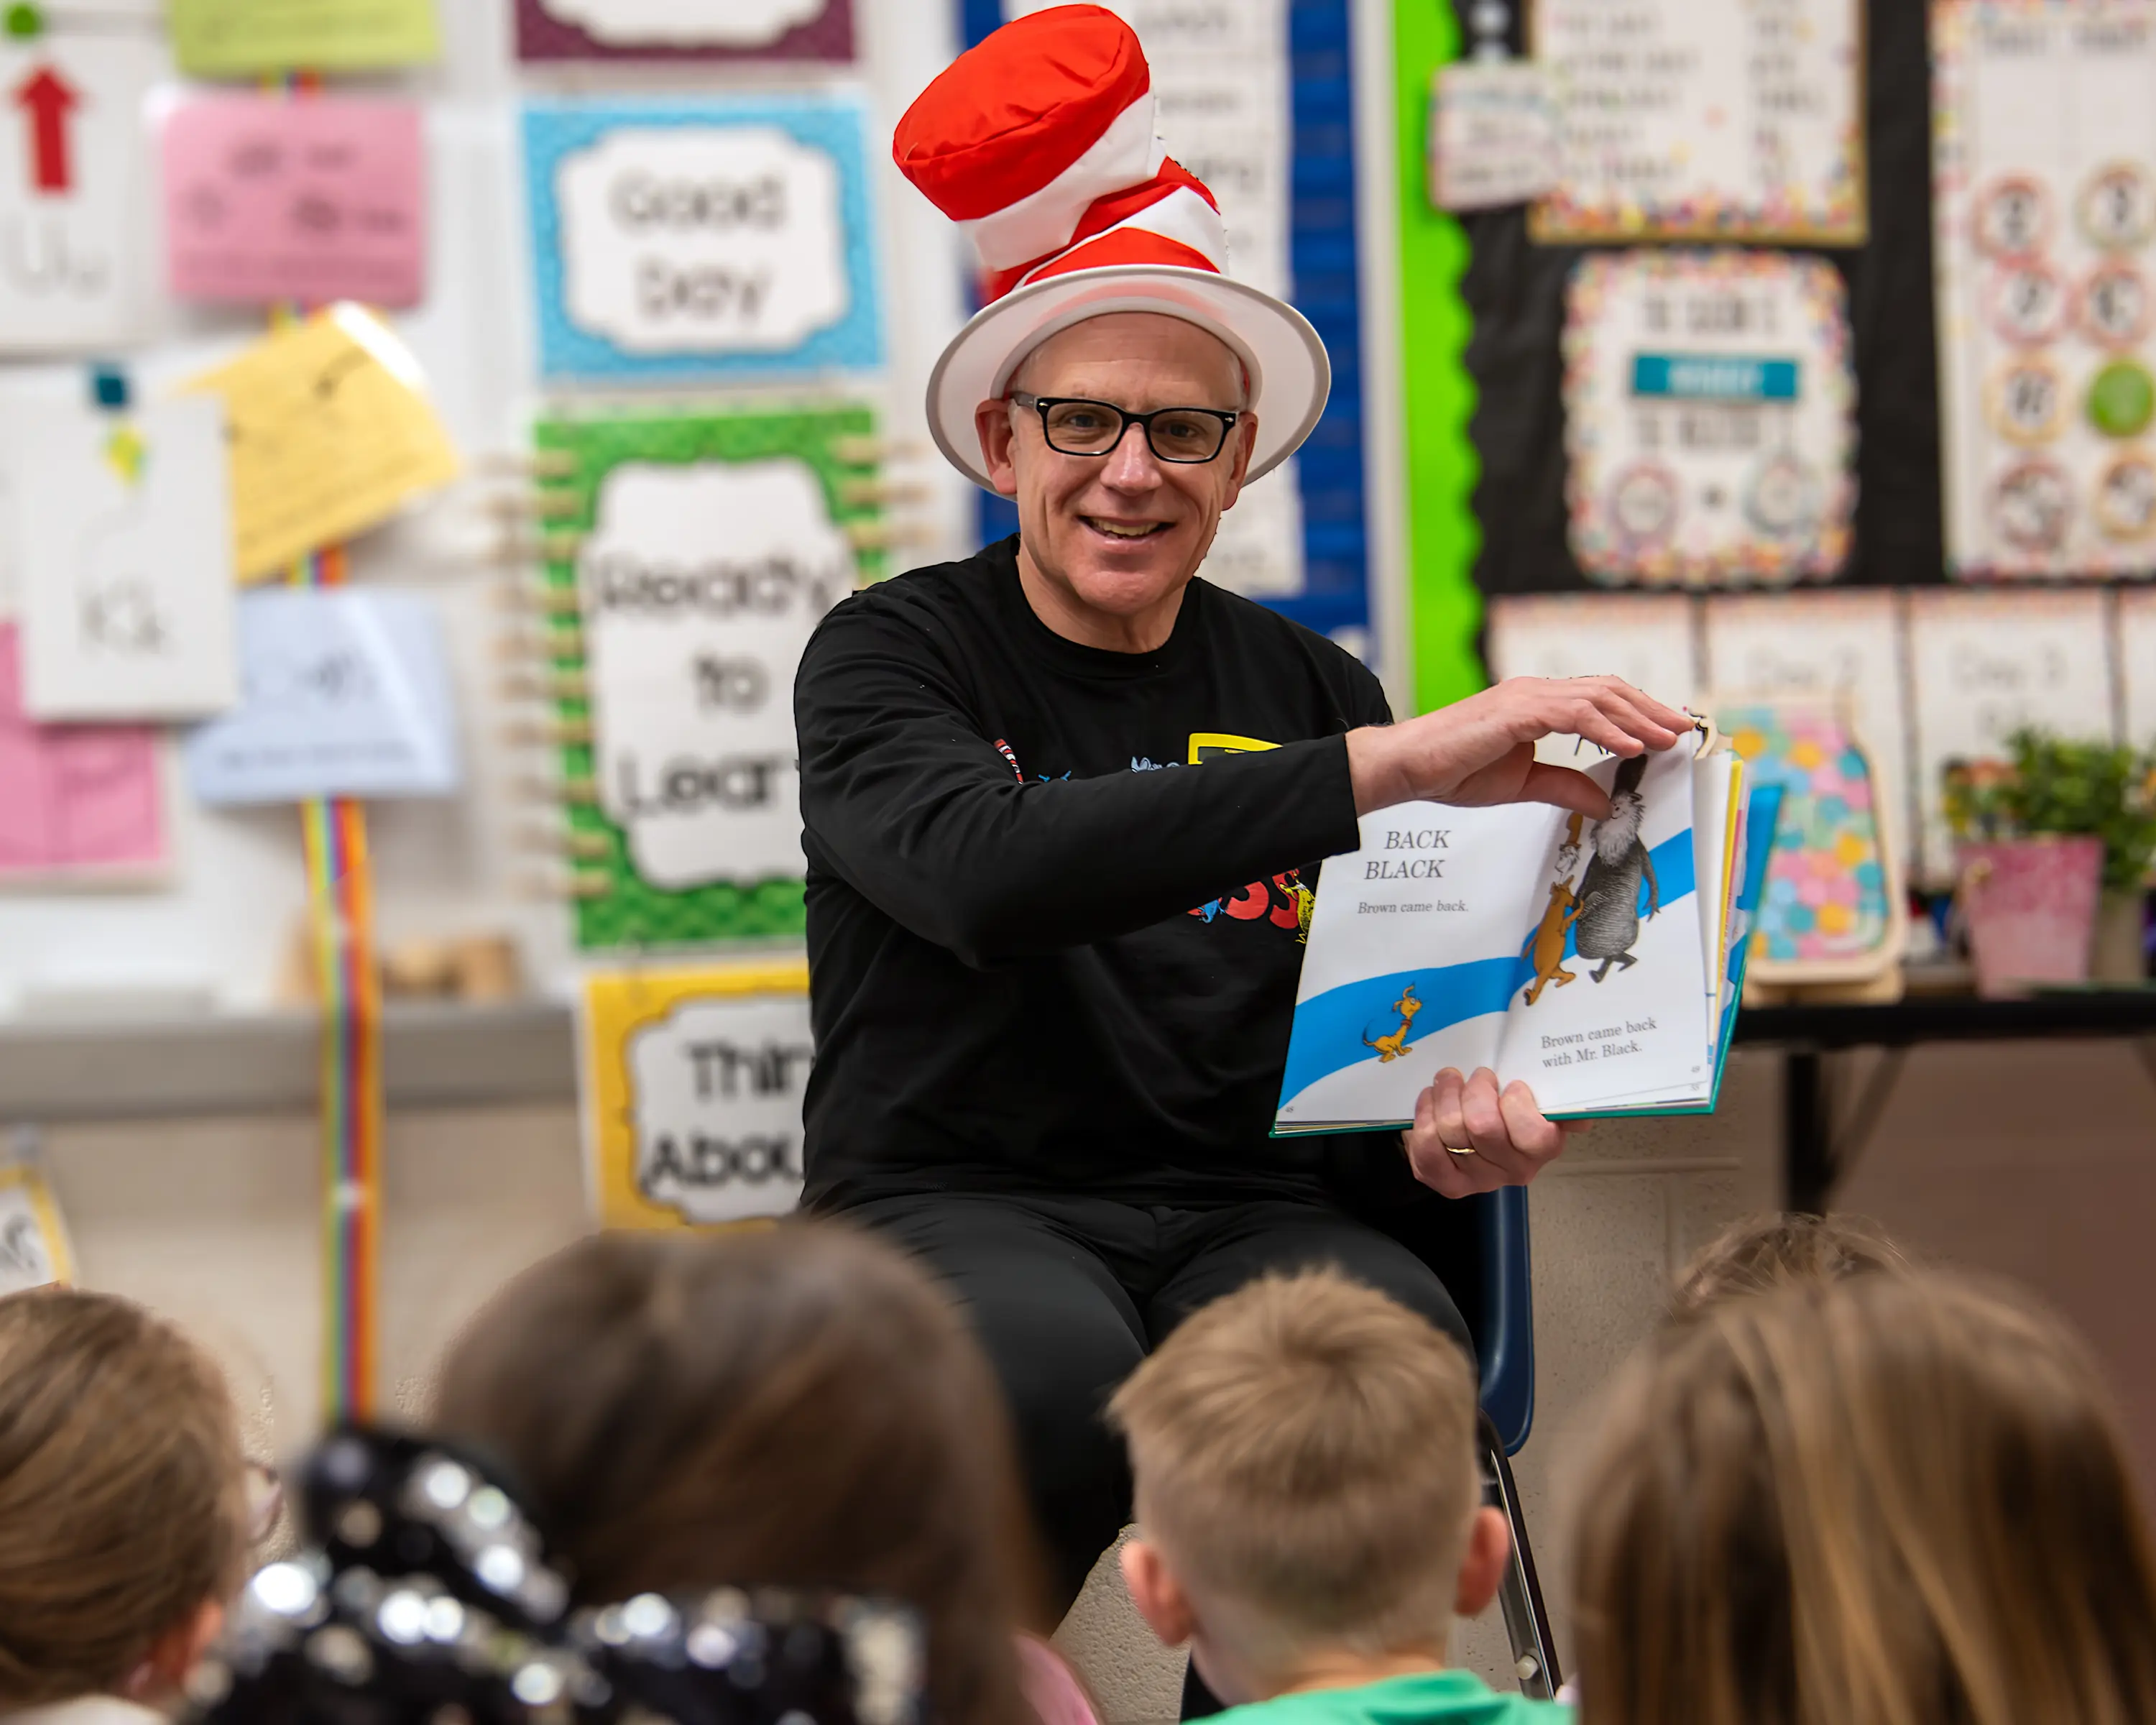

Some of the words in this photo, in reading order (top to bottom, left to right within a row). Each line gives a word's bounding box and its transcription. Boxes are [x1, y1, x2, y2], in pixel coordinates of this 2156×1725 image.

[611, 168, 786, 236] Good
[637, 257, 772, 327] Day
[598, 548, 847, 621] Ready
[694, 653, 769, 713] to
[618, 753, 798, 816] Lear
[1383, 829, 1452, 850] BACK
[1363, 859, 1446, 880] BLACK
[1357, 901, 1398, 915] Brown
[1400, 903, 1433, 913] came
[1436, 900, 1469, 912] back.
[1540, 1035, 1585, 1049] Brown
[1587, 1026, 1623, 1041] came
[1626, 1016, 1658, 1034] back
[1542, 1052, 1572, 1068] with
[1575, 1048, 1598, 1063] Mr.
[1602, 1040, 1643, 1058] Black.
[683, 1038, 812, 1101] Thin
[642, 1131, 802, 1190] Abou
